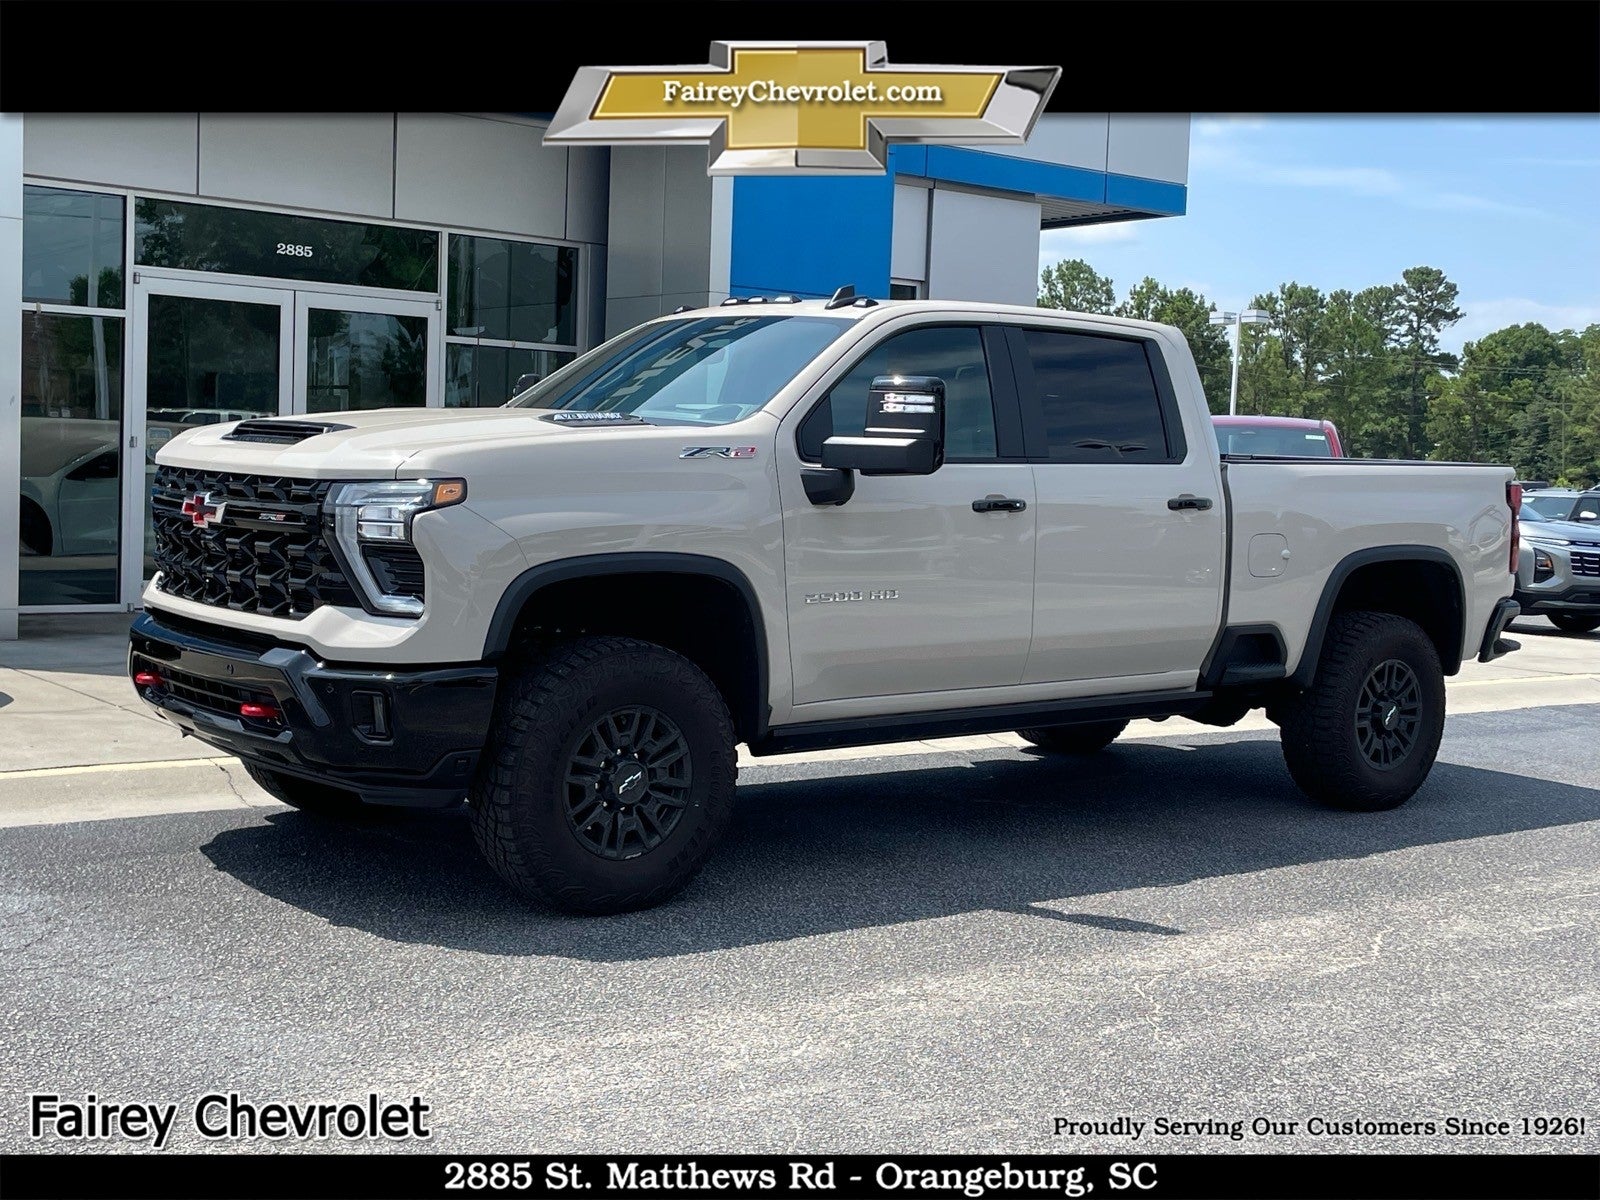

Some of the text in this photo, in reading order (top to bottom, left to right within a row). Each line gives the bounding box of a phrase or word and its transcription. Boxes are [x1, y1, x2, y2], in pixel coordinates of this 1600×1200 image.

[276, 242, 313, 257] 2885
[804, 588, 900, 604] 2500 HD
